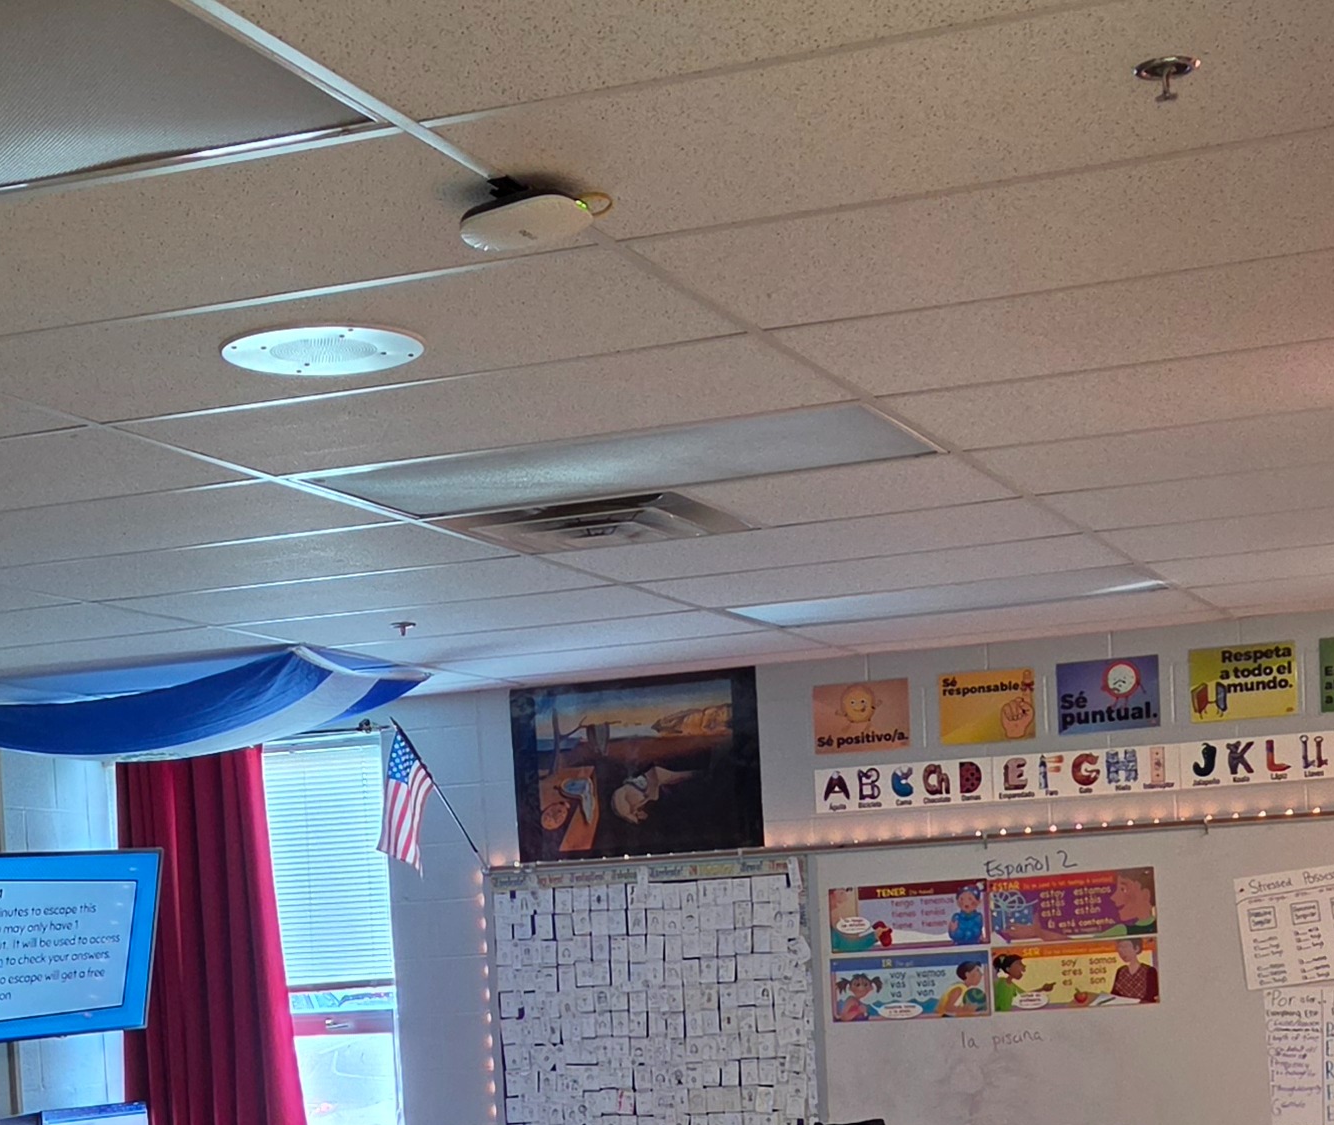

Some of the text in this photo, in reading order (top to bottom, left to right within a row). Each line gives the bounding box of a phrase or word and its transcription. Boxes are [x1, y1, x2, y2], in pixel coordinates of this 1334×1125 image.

[1221, 644, 1292, 664] Respeta
[1219, 661, 1292, 680] a todo el
[942, 677, 957, 688] Sé
[1228, 676, 1293, 695] mundo.
[1060, 691, 1088, 710] Sé
[1325, 694, 1334, 704] a
[1061, 702, 1158, 728] puntual.
[817, 729, 909, 751] Sé positivo/a.
[984, 850, 1077, 879] Español 2
[876, 888, 906, 898] TENER
[1073, 886, 1112, 896] estamos
[1248, 878, 1293, 895] Stressed
[32, 907, 41, 916] to
[43, 906, 77, 916] escape
[80, 903, 97, 913] this
[4, 925, 25, 936] may
[28, 922, 47, 934] only
[50, 921, 73, 931] have
[13, 940, 20, 948] It
[22, 938, 37, 948] will
[39, 938, 51, 948] be
[53, 936, 75, 946] used
[78, 936, 87, 945] to
[90, 934, 121, 944] access
[6, 956, 16, 966] to
[18, 954, 46, 965] check
[48, 953, 69, 965] your
[1061, 957, 1117, 968] soy somos
[8, 974, 42, 985] escape
[45, 970, 60, 980] will
[61, 970, 77, 983] get
[78, 970, 86, 979] a
[87, 967, 105, 977] free
[890, 970, 946, 980] voy vamos
[1061, 966, 1107, 977] eres sois
[890, 979, 936, 989] vas vais
[1062, 976, 1106, 987] es son
[916, 989, 935, 997] van
[1271, 989, 1296, 1006] Por
[961, 1031, 979, 1049] la
